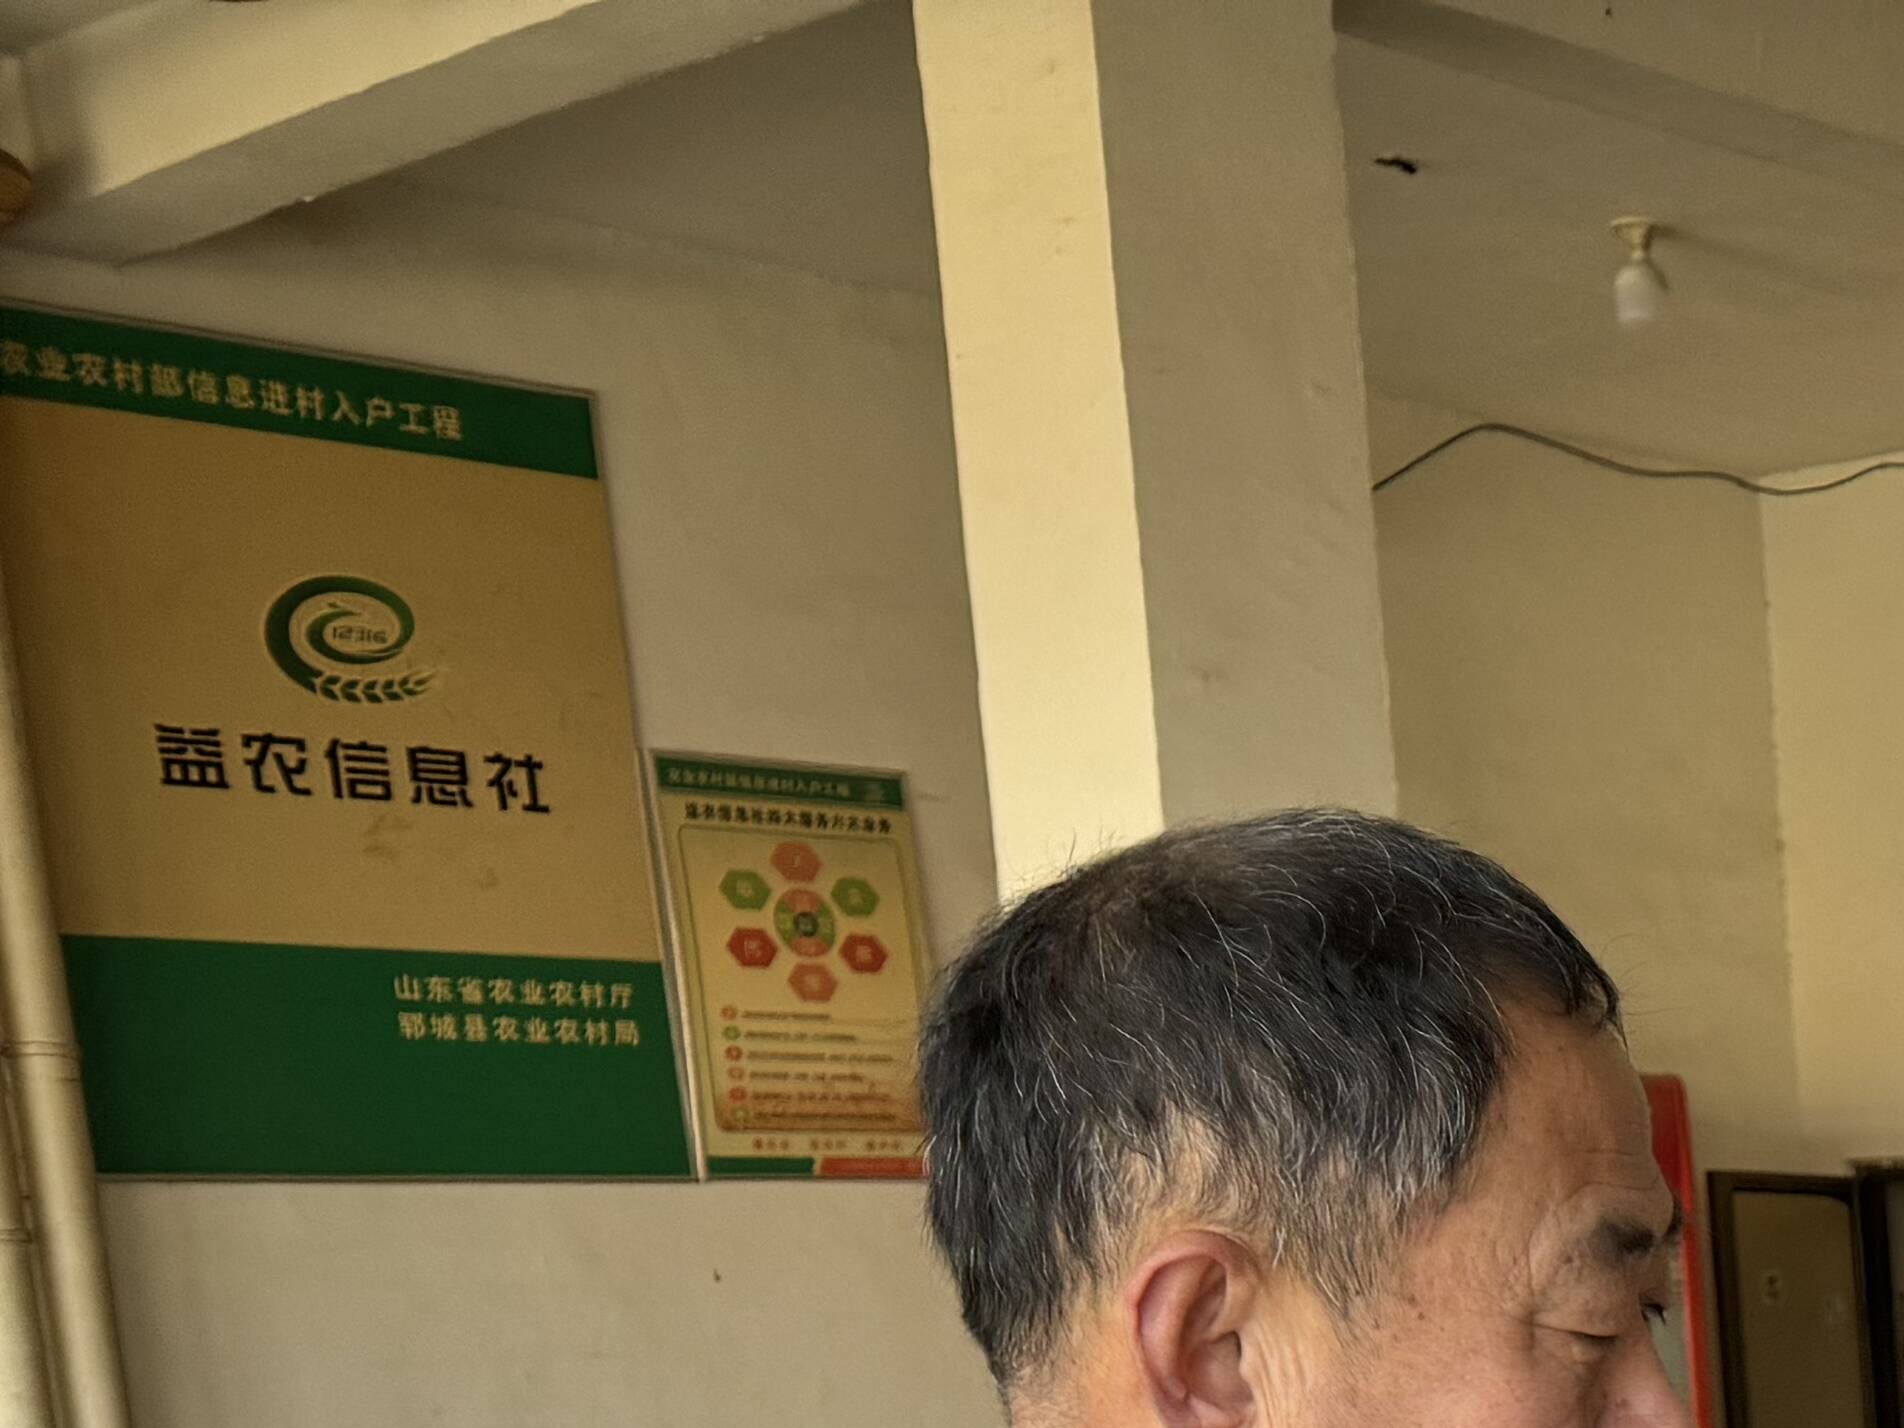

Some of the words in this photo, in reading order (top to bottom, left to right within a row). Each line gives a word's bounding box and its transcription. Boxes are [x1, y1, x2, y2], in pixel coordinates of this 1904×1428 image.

[154, 724, 551, 814] 益农信息社
[394, 974, 634, 1010] 山东省农业农村厅
[398, 1011, 640, 1047] 鄄城县农业农村局
